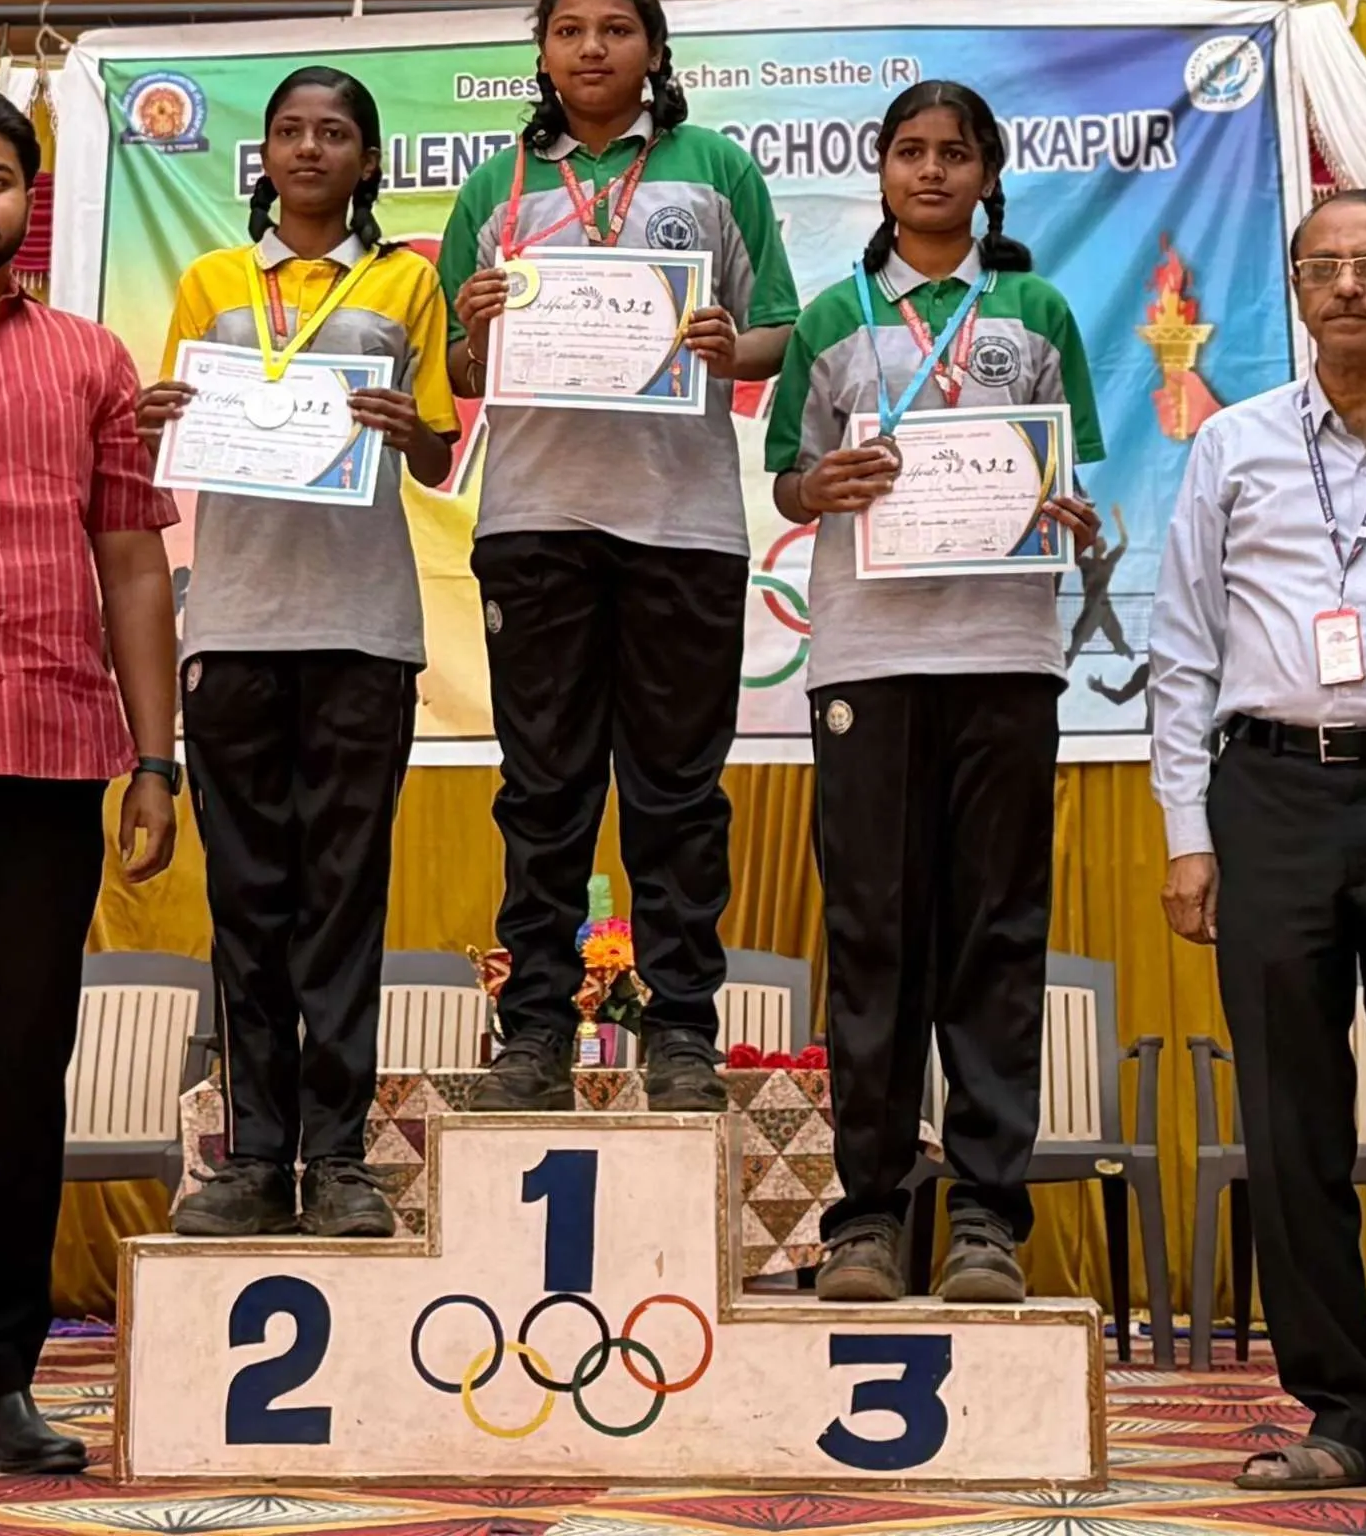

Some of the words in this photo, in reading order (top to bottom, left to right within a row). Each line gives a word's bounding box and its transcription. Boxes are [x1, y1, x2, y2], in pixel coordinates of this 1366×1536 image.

[456, 74, 540, 99] Danes
[760, 60, 872, 86] Sansthe
[881, 57, 920, 89] (R)
[721, 120, 884, 175] CHOO
[999, 113, 1173, 170] KAPUR
[521, 1149, 599, 1293] 1
[225, 1275, 332, 1444] 2
[816, 1333, 953, 1471] 3
